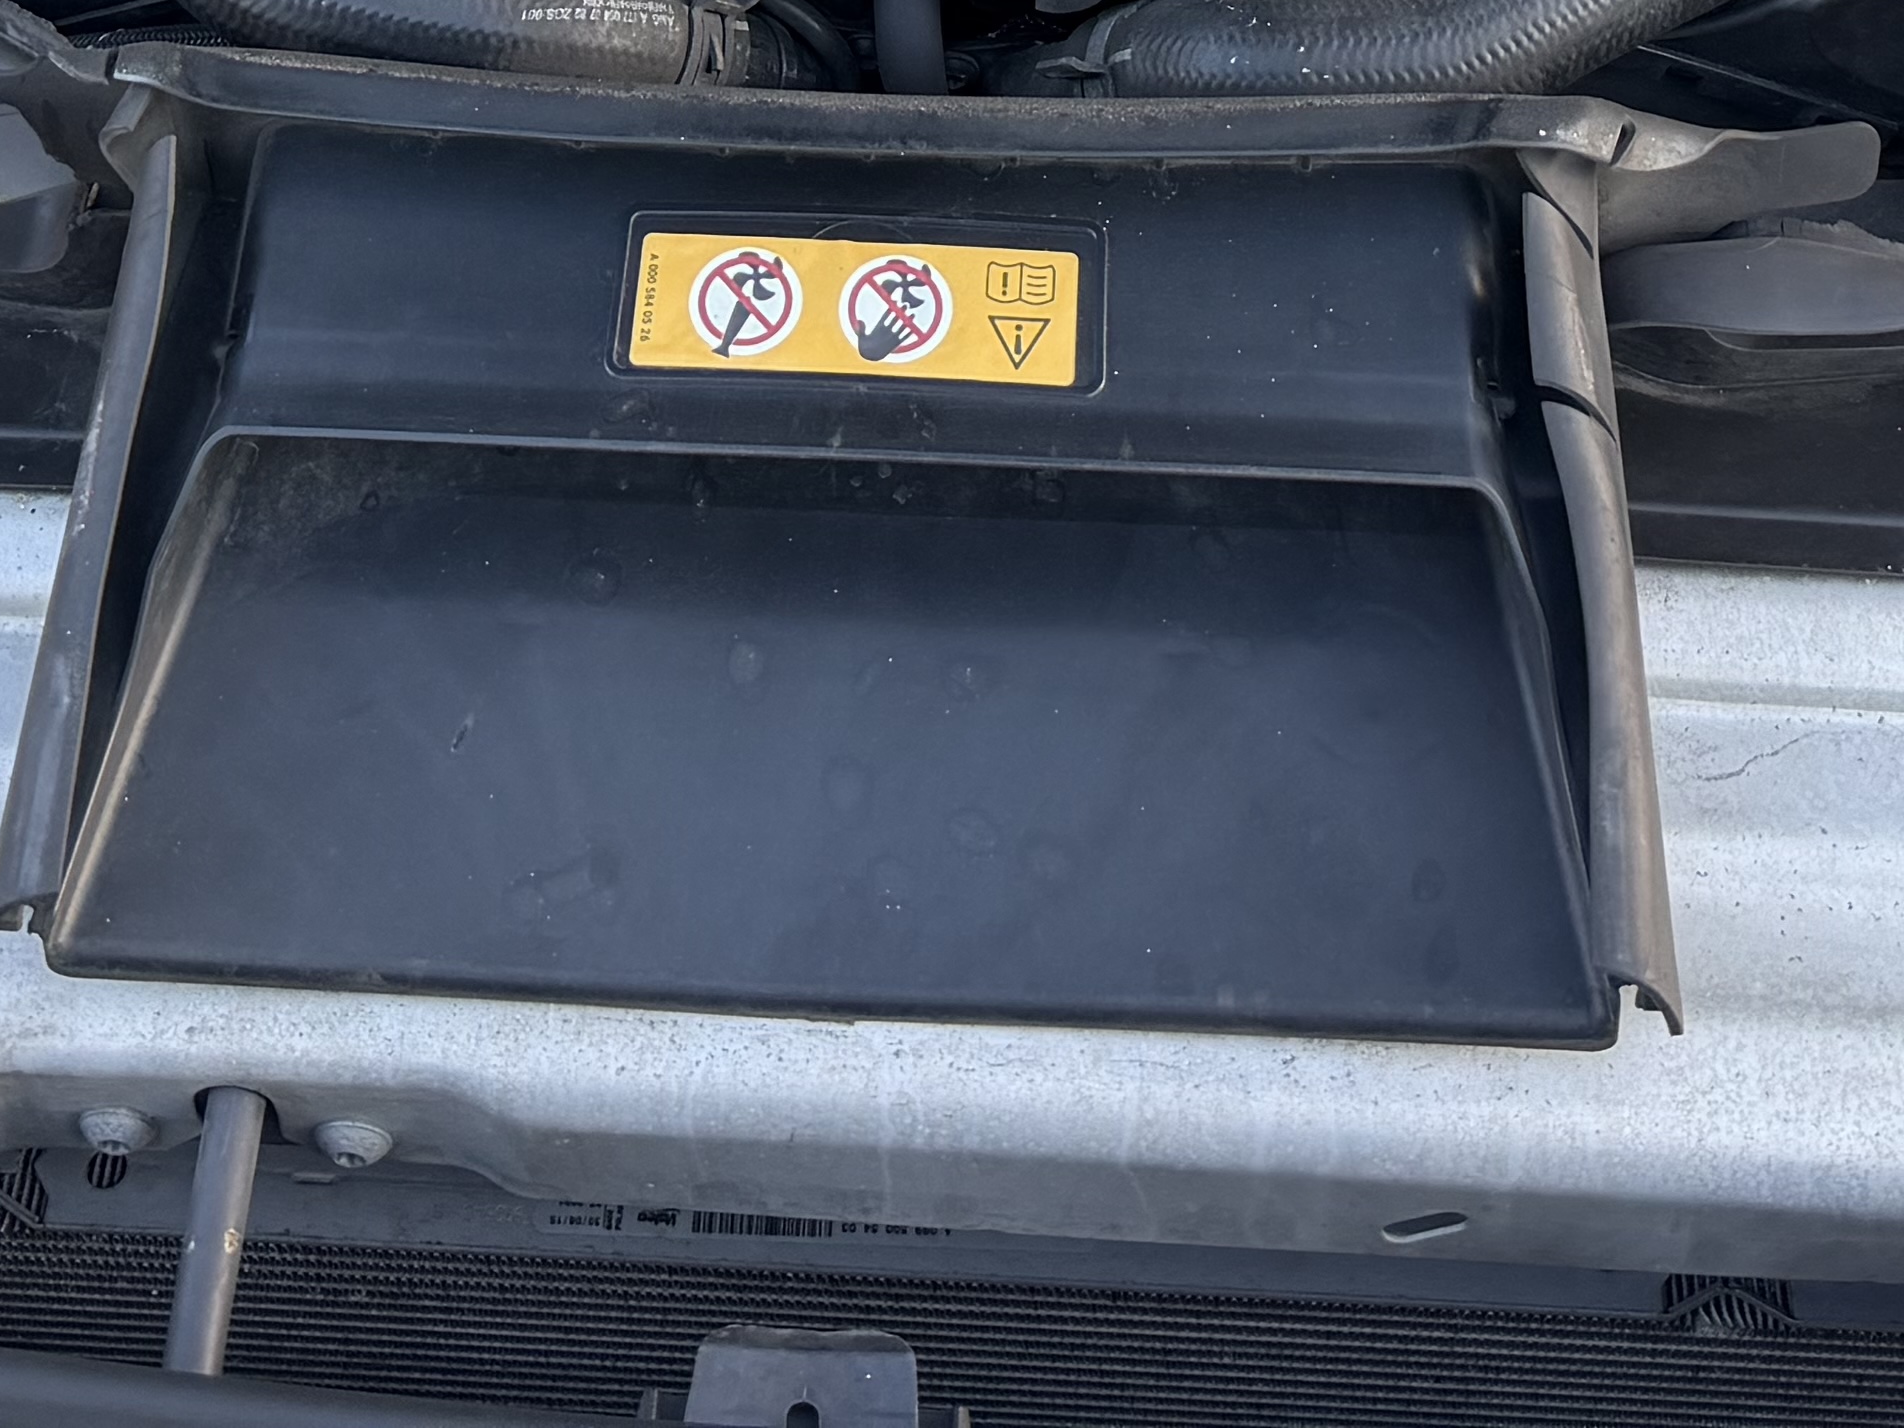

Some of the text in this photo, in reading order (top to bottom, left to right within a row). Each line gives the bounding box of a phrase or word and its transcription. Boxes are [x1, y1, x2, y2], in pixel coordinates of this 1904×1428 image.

[647, 264, 659, 284] 000
[645, 287, 656, 306] 584
[642, 311, 653, 324] 05
[640, 328, 650, 342] 26
